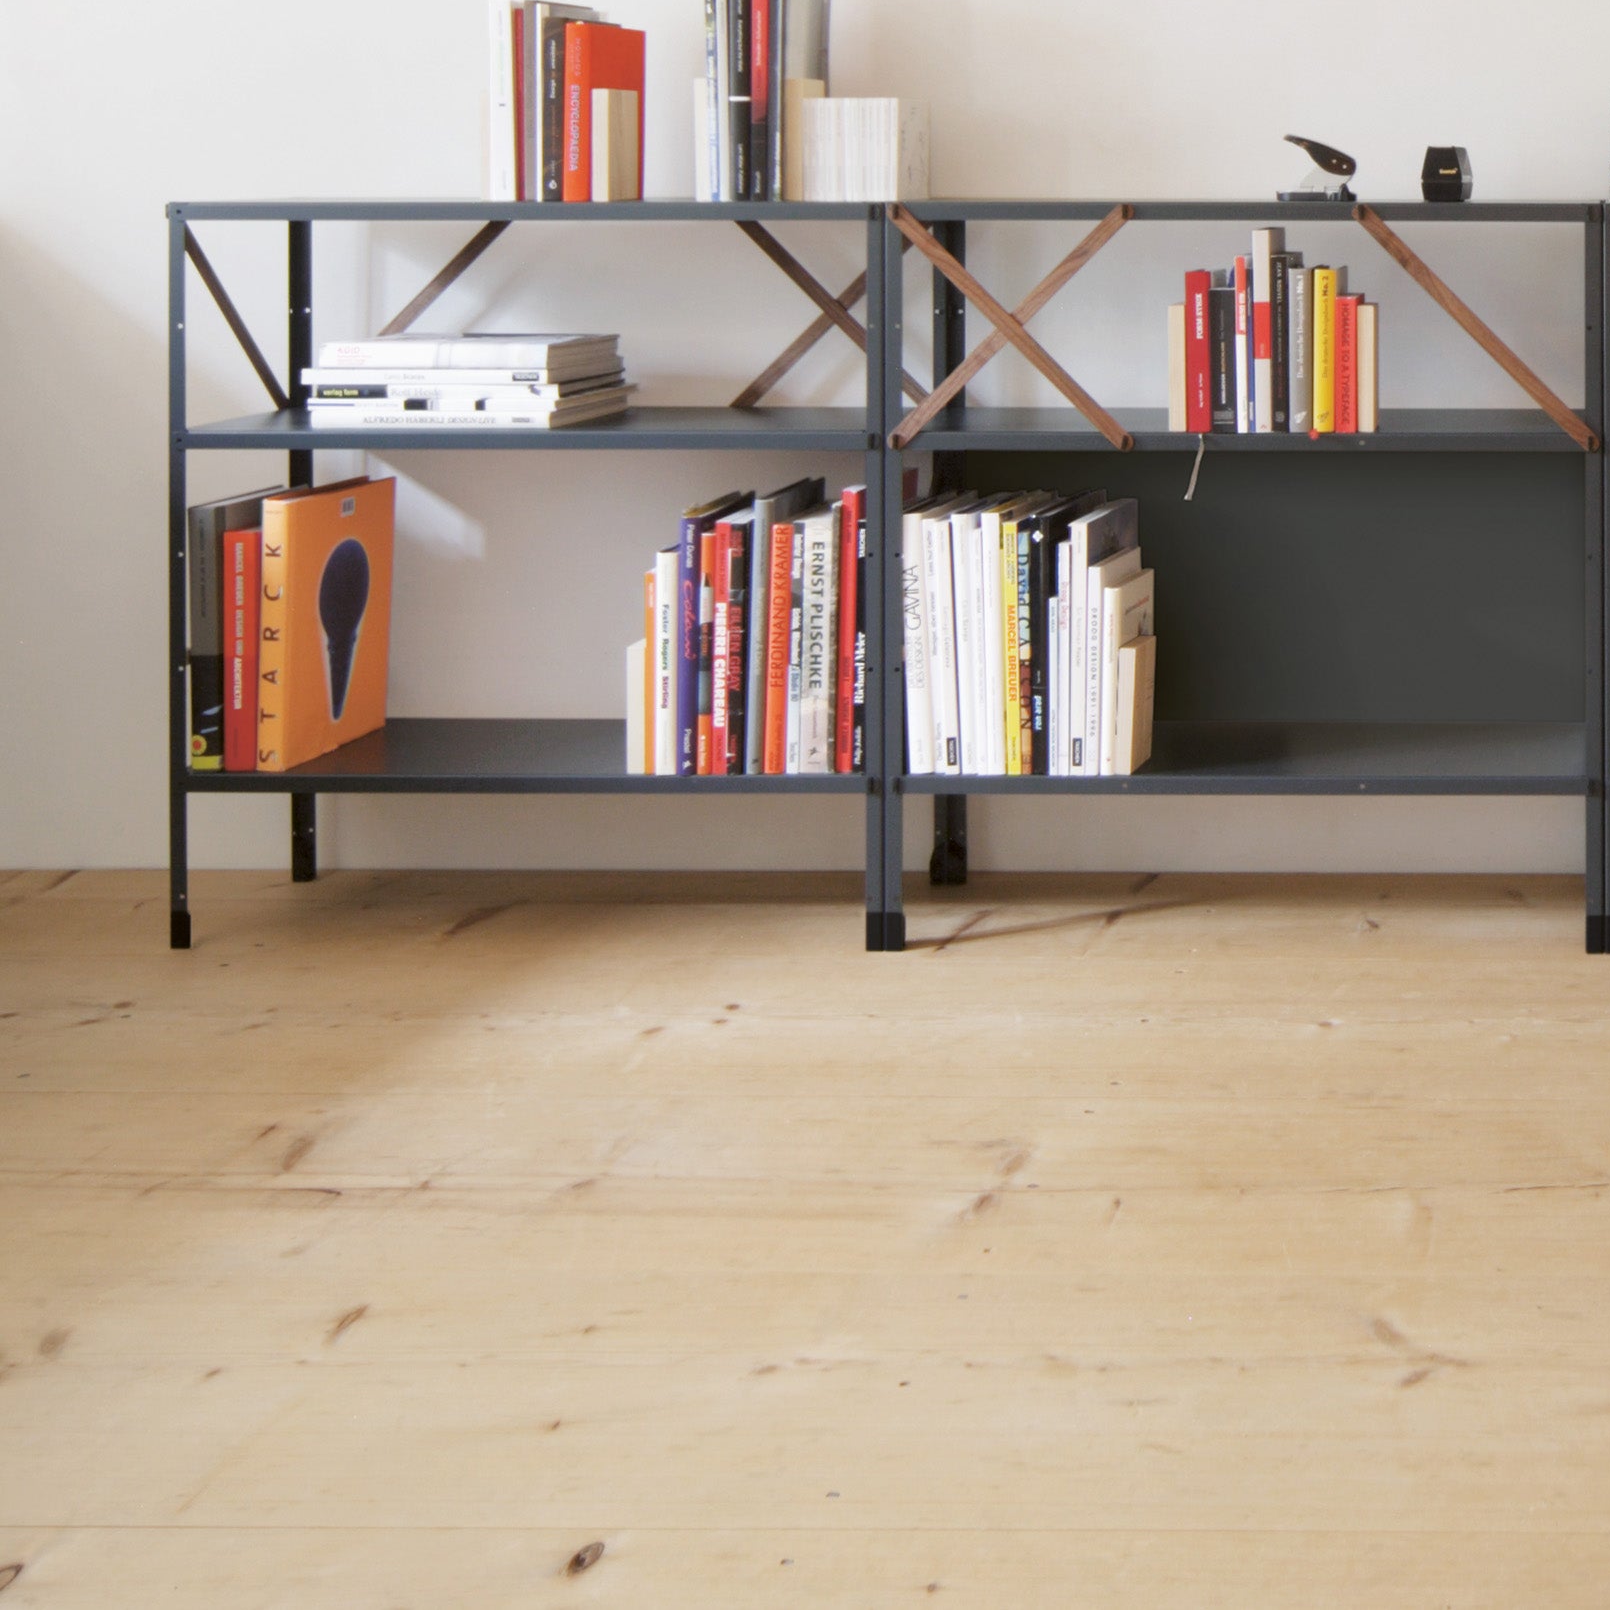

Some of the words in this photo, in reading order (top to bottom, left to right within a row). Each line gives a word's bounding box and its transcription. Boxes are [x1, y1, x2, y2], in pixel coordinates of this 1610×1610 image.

[568, 84, 580, 172] ENCYCLOPAEDIA
[1341, 303, 1350, 348] HOMAGE
[1340, 375, 1350, 425] TYPEFACE
[686, 524, 695, 544] Peter
[234, 542, 244, 574] MARCEL
[772, 526, 789, 590] KRAMER
[811, 541, 825, 597] ERNST
[1018, 554, 1030, 607] David
[661, 603, 670, 634] Foster
[903, 565, 921, 631] GAVINA
[714, 602, 727, 656] PIERRE
[729, 606, 742, 653] EILEEN
[770, 596, 787, 688] FERDINAND
[809, 603, 824, 690] PLISCHKE
[854, 632, 865, 660] Meier
[1007, 605, 1016, 652] MARCEL
[1090, 607, 1098, 641] DROOG
[259, 543, 283, 764] STARCK
[660, 638, 670, 671] Rogers
[728, 655, 741, 691] GRAY
[1089, 646, 1097, 680] DESIGN
[233, 657, 243, 710] ARCHITEKTUR
[660, 676, 670, 709] Stirling
[713, 659, 727, 728] CHAREAU
[854, 662, 865, 704] Richard
[1007, 655, 1017, 702] BREUER
